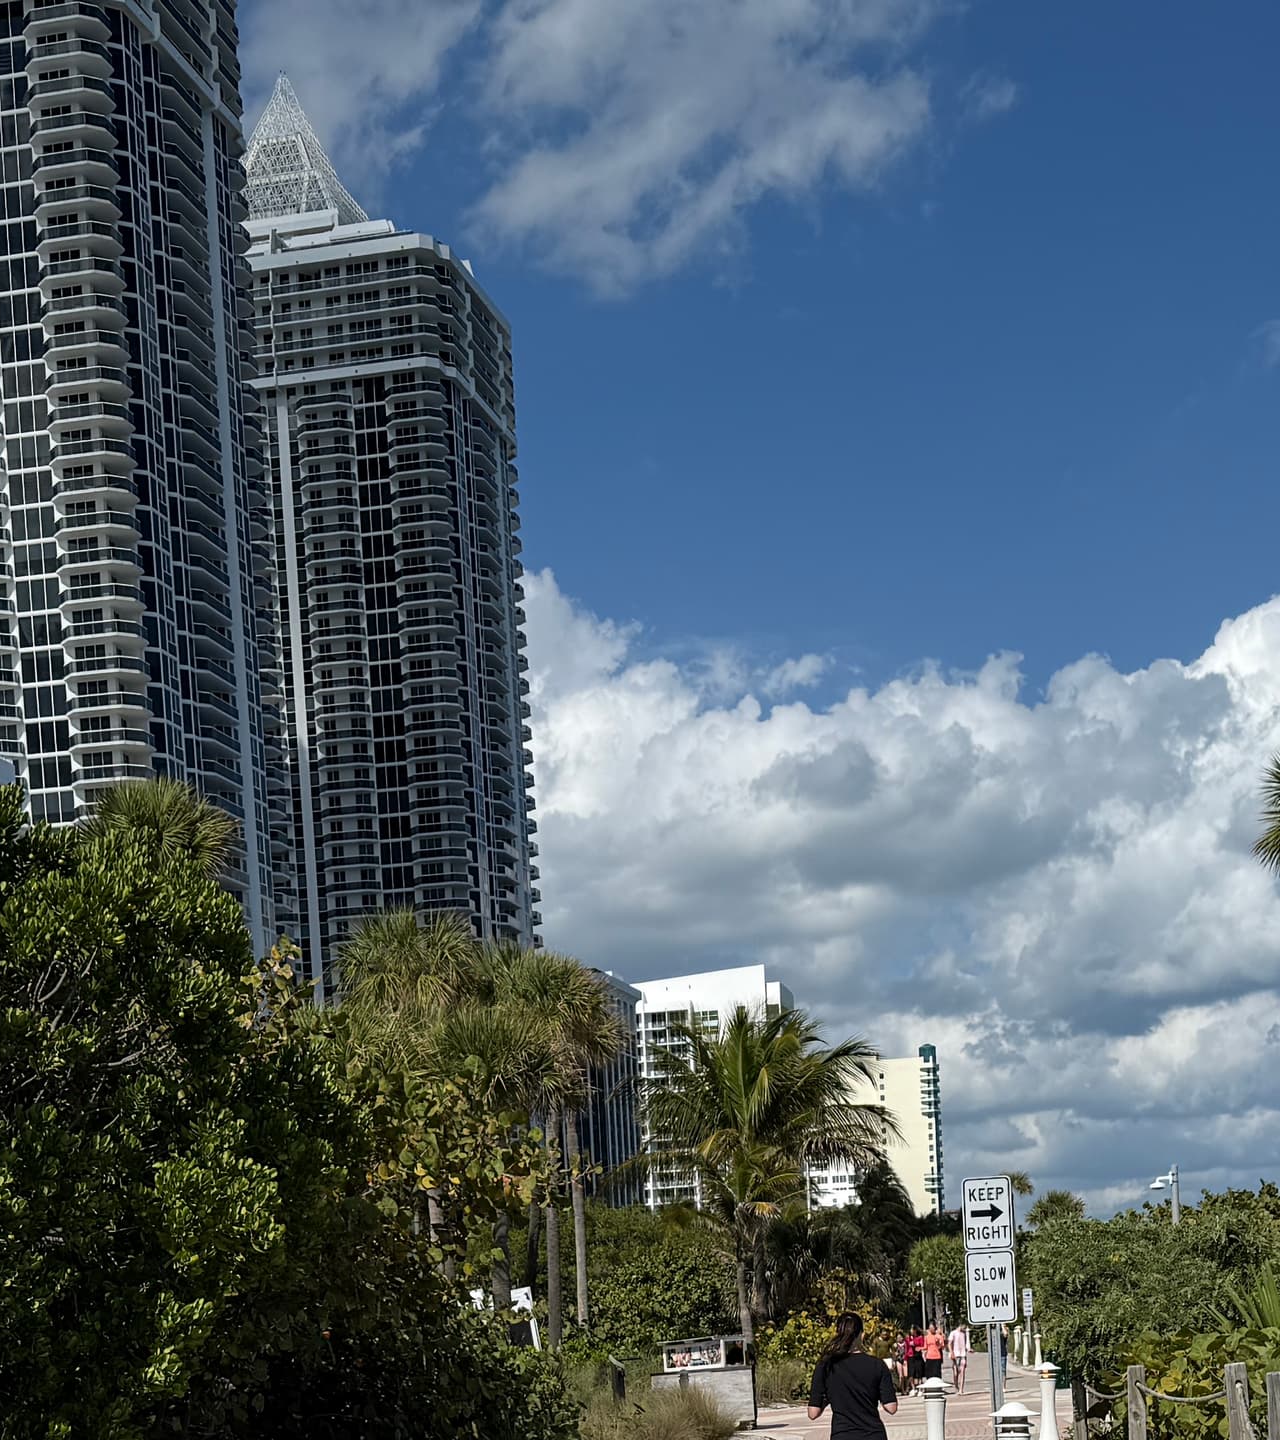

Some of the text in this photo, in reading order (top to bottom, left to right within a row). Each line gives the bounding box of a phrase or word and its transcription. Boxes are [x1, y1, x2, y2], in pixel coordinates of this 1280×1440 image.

[968, 1186, 1004, 1202] KEEP
[967, 1225, 1009, 1240] RIGHT
[974, 1266, 1007, 1281] SLOW
[975, 1293, 1009, 1308] DOWN
